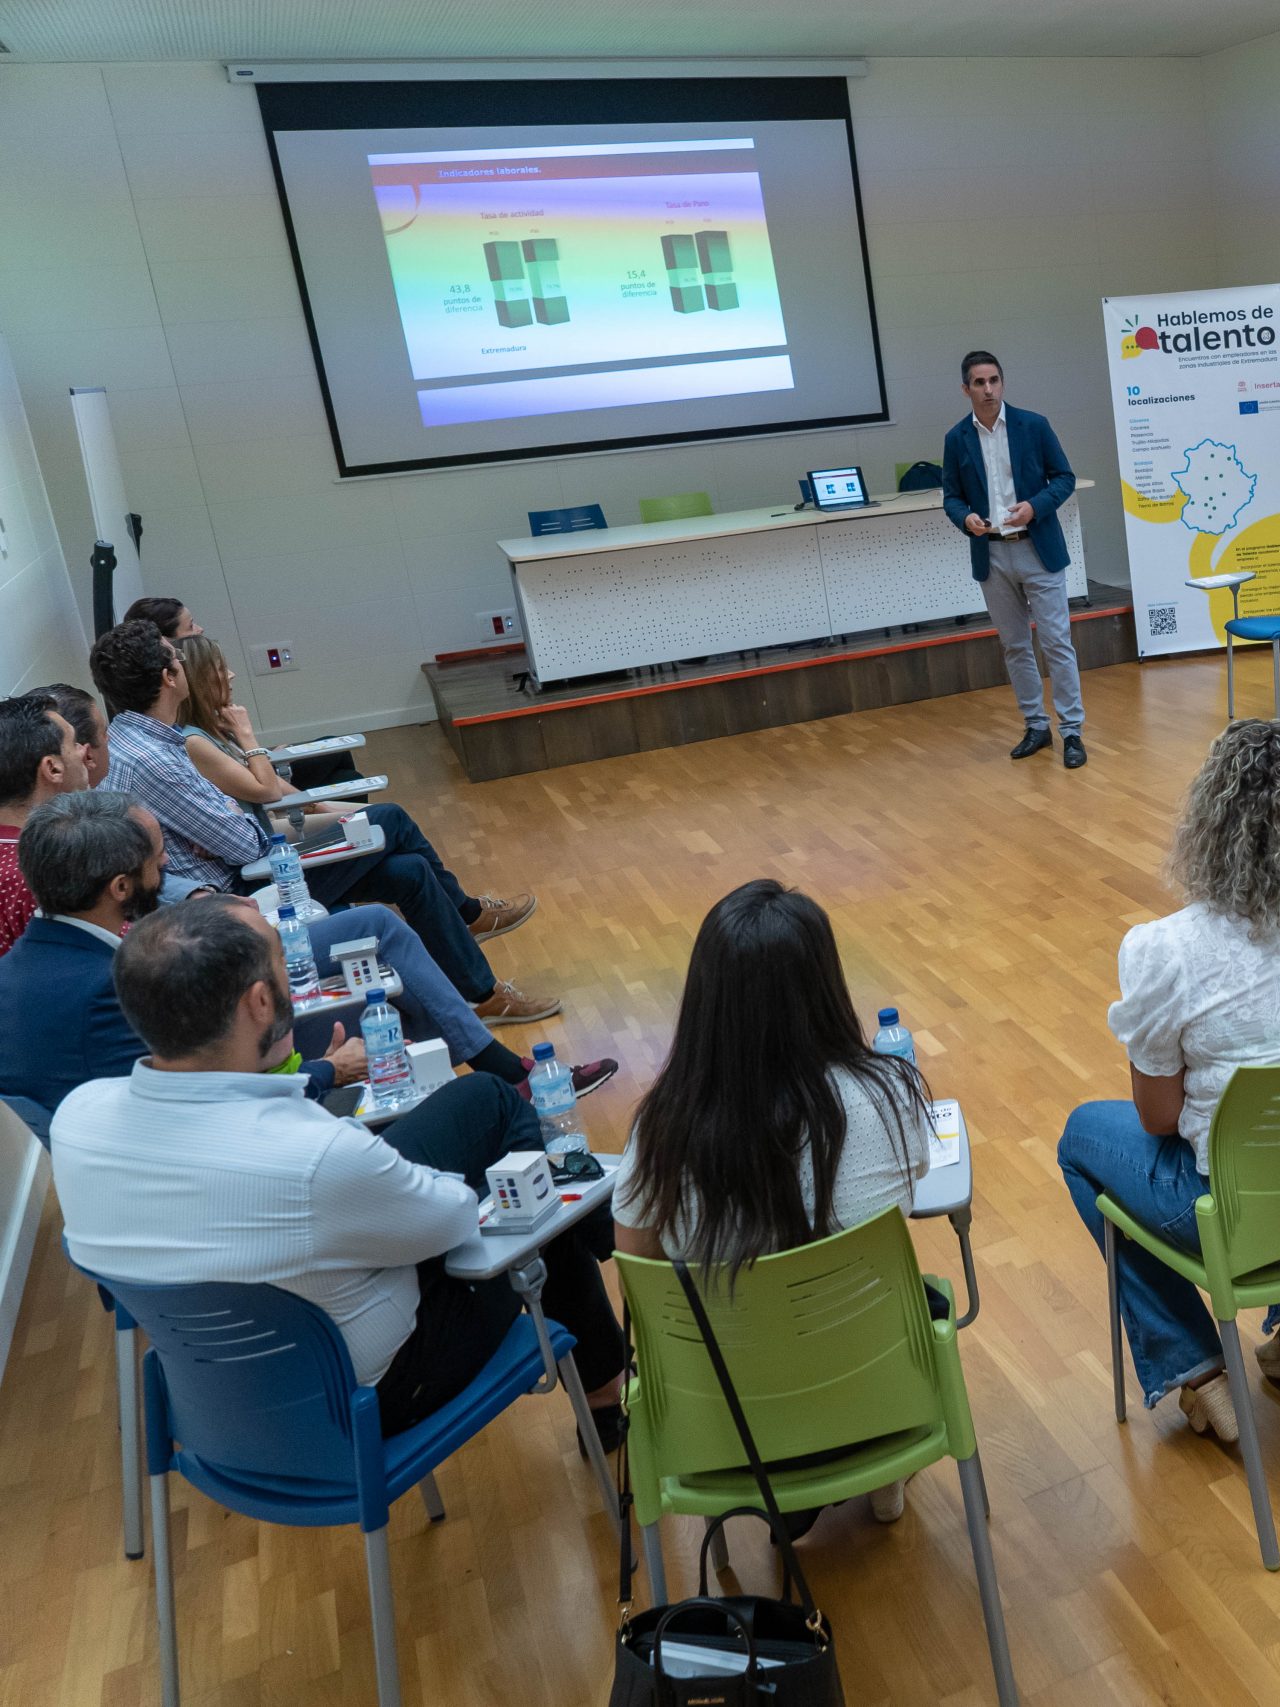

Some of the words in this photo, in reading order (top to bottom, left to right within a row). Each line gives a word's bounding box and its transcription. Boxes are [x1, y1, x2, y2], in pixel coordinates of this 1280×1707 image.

[438, 168, 494, 178] Indicadores
[496, 165, 542, 175] laborales.
[480, 211, 497, 219] Tasa
[510, 208, 544, 217] actividad
[627, 270, 646, 280] 15,4
[449, 284, 471, 294] 43,8
[620, 282, 645, 291] puntos
[622, 289, 657, 297] diferencia
[443, 297, 470, 306] puntos
[472, 295, 482, 303] de
[444, 304, 483, 313] diferencia
[1157, 309, 1246, 327] Hablemos
[1251, 305, 1273, 319] de
[1159, 324, 1276, 354] talento
[480, 344, 527, 355] Extremadura
[1178, 355, 1209, 363] Encuentros
[1254, 381, 1280, 390] Inserta
[1126, 386, 1140, 396] 10
[1128, 393, 1195, 406] localizaciones
